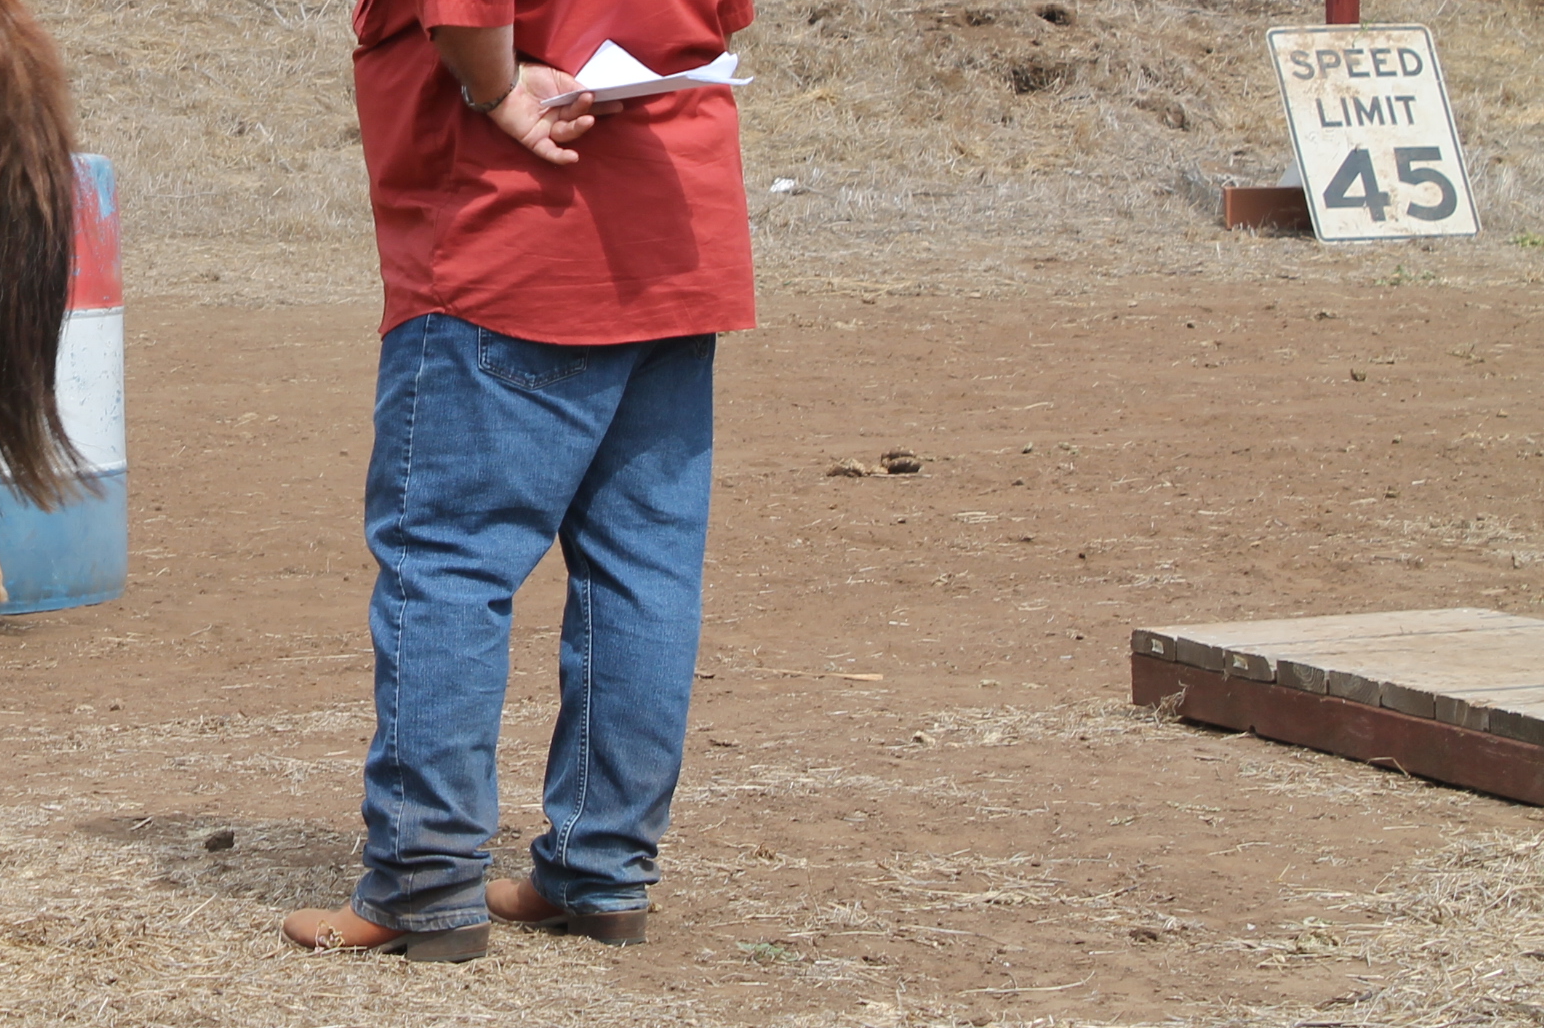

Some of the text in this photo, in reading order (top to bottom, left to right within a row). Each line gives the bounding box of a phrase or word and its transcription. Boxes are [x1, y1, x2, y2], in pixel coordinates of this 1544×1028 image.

[1290, 47, 1424, 80] SPEED
[1315, 95, 1416, 128] LIMIT
[1323, 146, 1458, 222] 45
